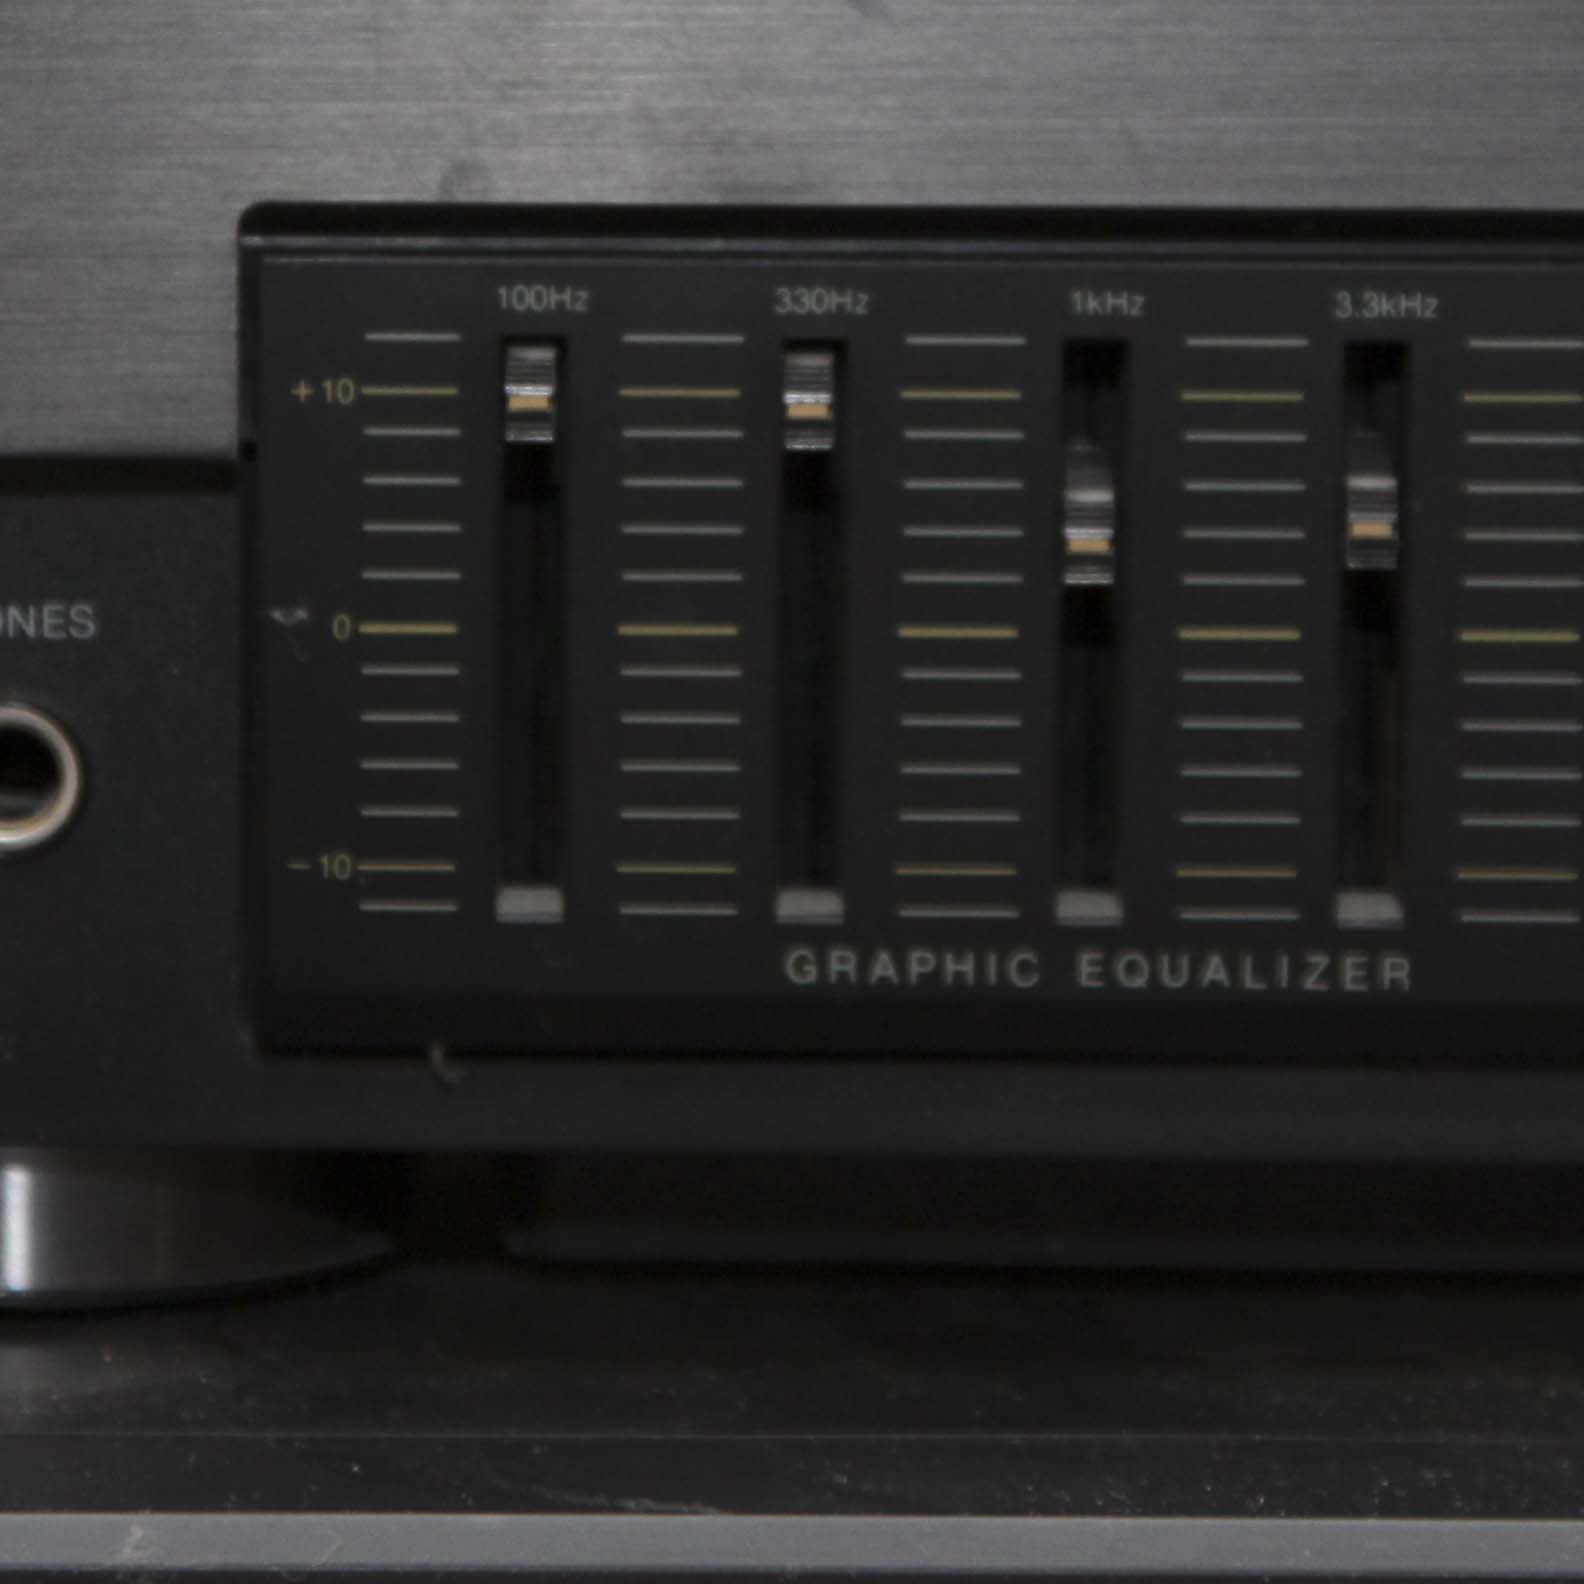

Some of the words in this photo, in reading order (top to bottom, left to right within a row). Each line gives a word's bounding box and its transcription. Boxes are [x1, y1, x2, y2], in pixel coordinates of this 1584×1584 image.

[496, 284, 590, 314] 100Hz
[774, 287, 870, 316] 330Hz
[1071, 289, 1146, 317] 1kHz
[1335, 290, 1440, 321] 3.3kHz
[783, 950, 1042, 992] GRAPHIC
[1076, 953, 1416, 997] EQUALIZER
